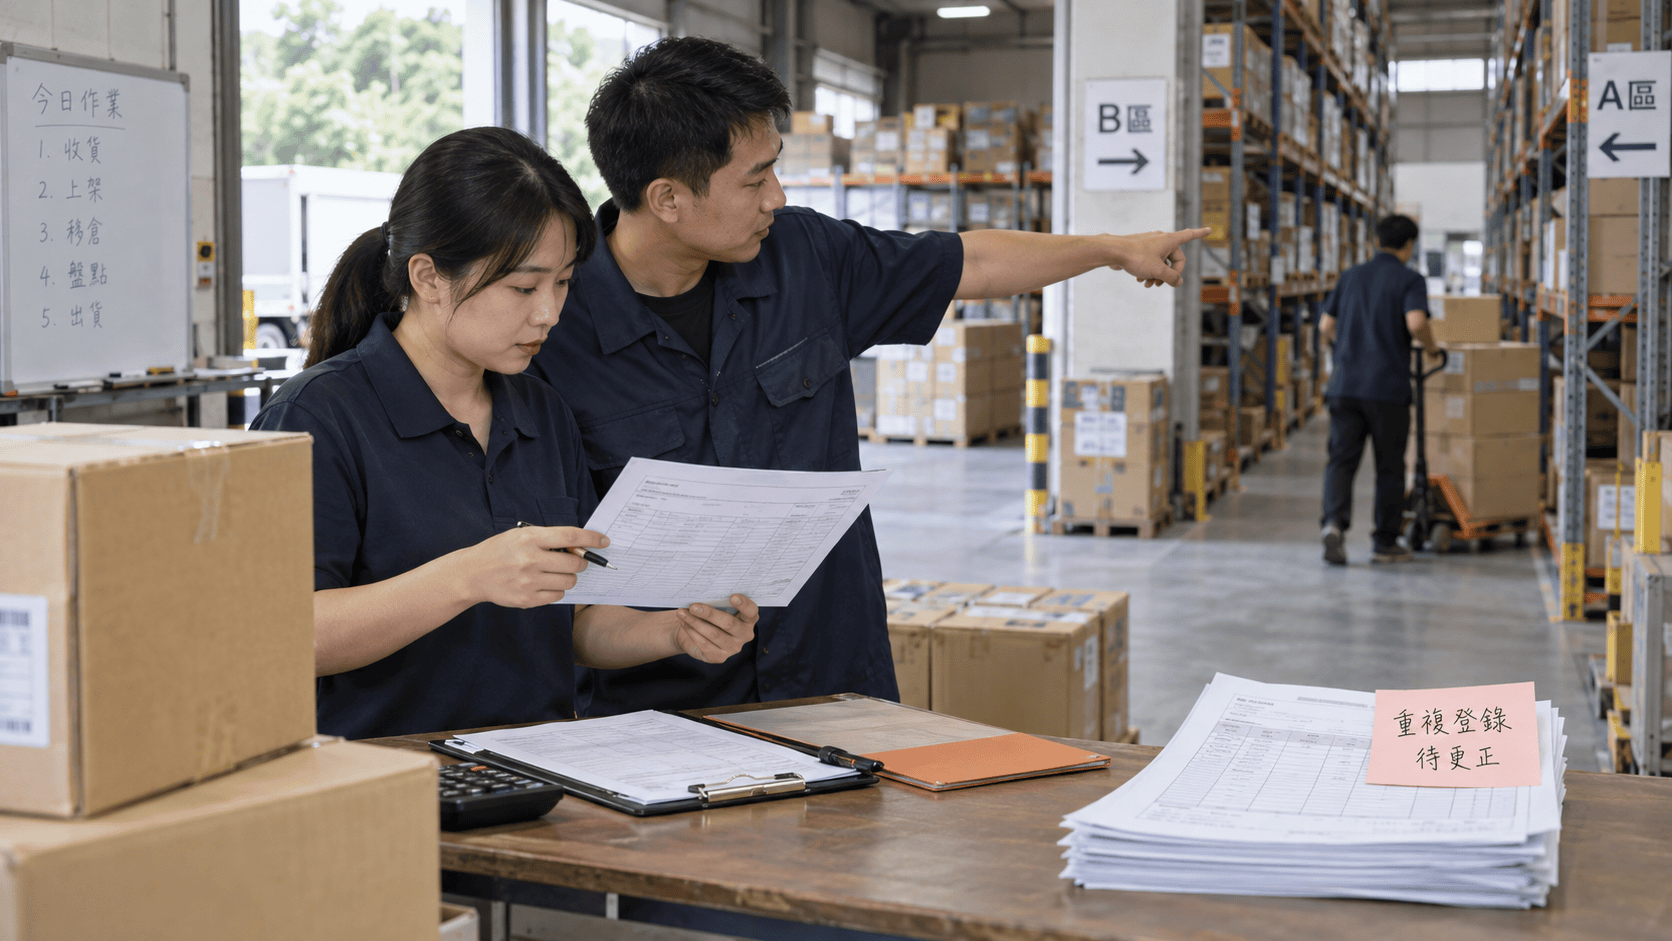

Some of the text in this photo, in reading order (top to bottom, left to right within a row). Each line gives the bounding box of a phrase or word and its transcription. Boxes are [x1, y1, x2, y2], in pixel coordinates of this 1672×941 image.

[31, 82, 123, 120] 今日作業
[1597, 80, 1657, 111] A區
[1098, 103, 1153, 133] B區
[39, 135, 101, 164] 1. 收貨
[38, 176, 103, 204] 2. 上架
[39, 216, 103, 247] 3. 移倉
[39, 260, 108, 290] 4. 盤點
[41, 300, 103, 329] 5. 出貨
[1393, 705, 1513, 738] 重複登錄
[1415, 744, 1501, 772] 待更正
